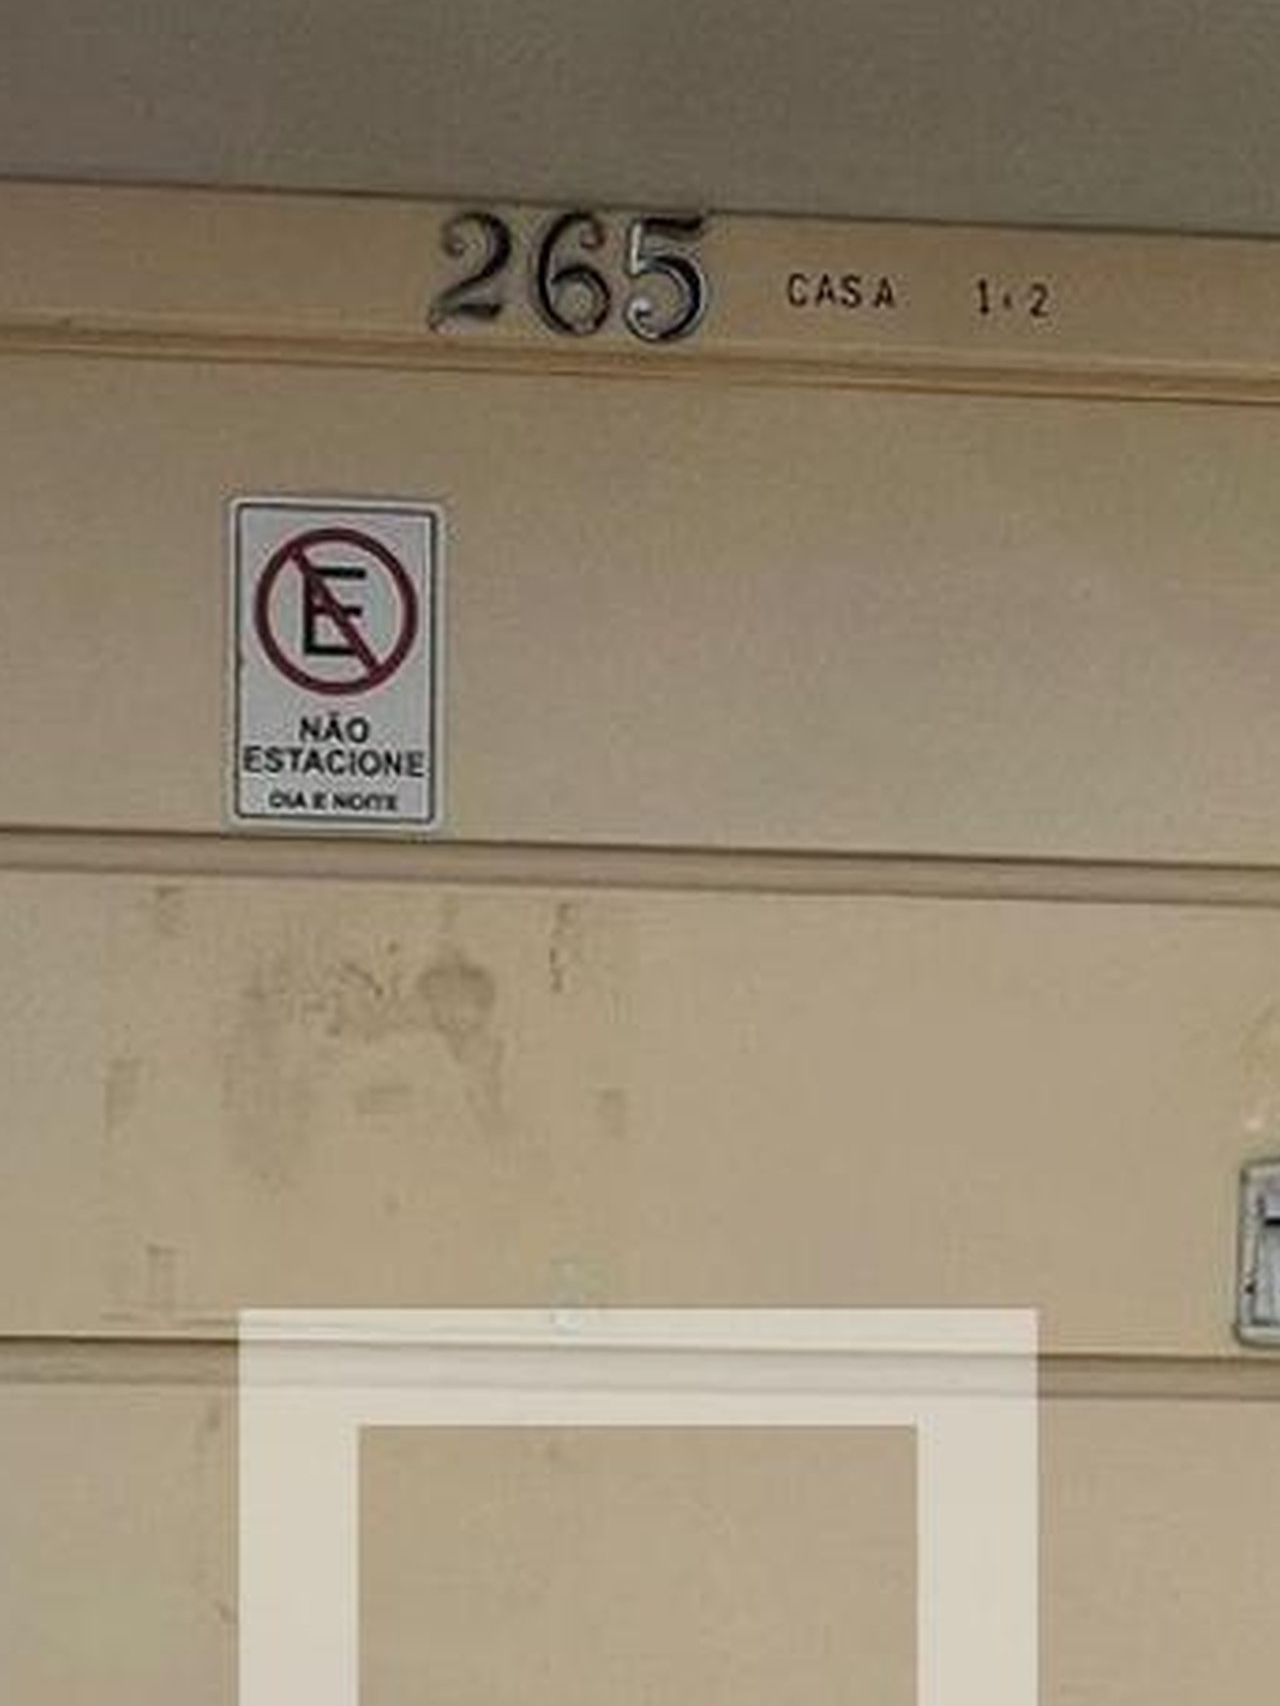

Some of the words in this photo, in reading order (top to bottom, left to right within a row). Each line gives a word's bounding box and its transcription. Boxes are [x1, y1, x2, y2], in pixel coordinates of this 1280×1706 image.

[426, 209, 711, 342] 265
[786, 272, 896, 308] CASA
[299, 710, 371, 745] NÃO
[242, 745, 425, 778] ESTACIONE
[269, 792, 308, 810] DIA
[332, 793, 399, 812] NOITE
